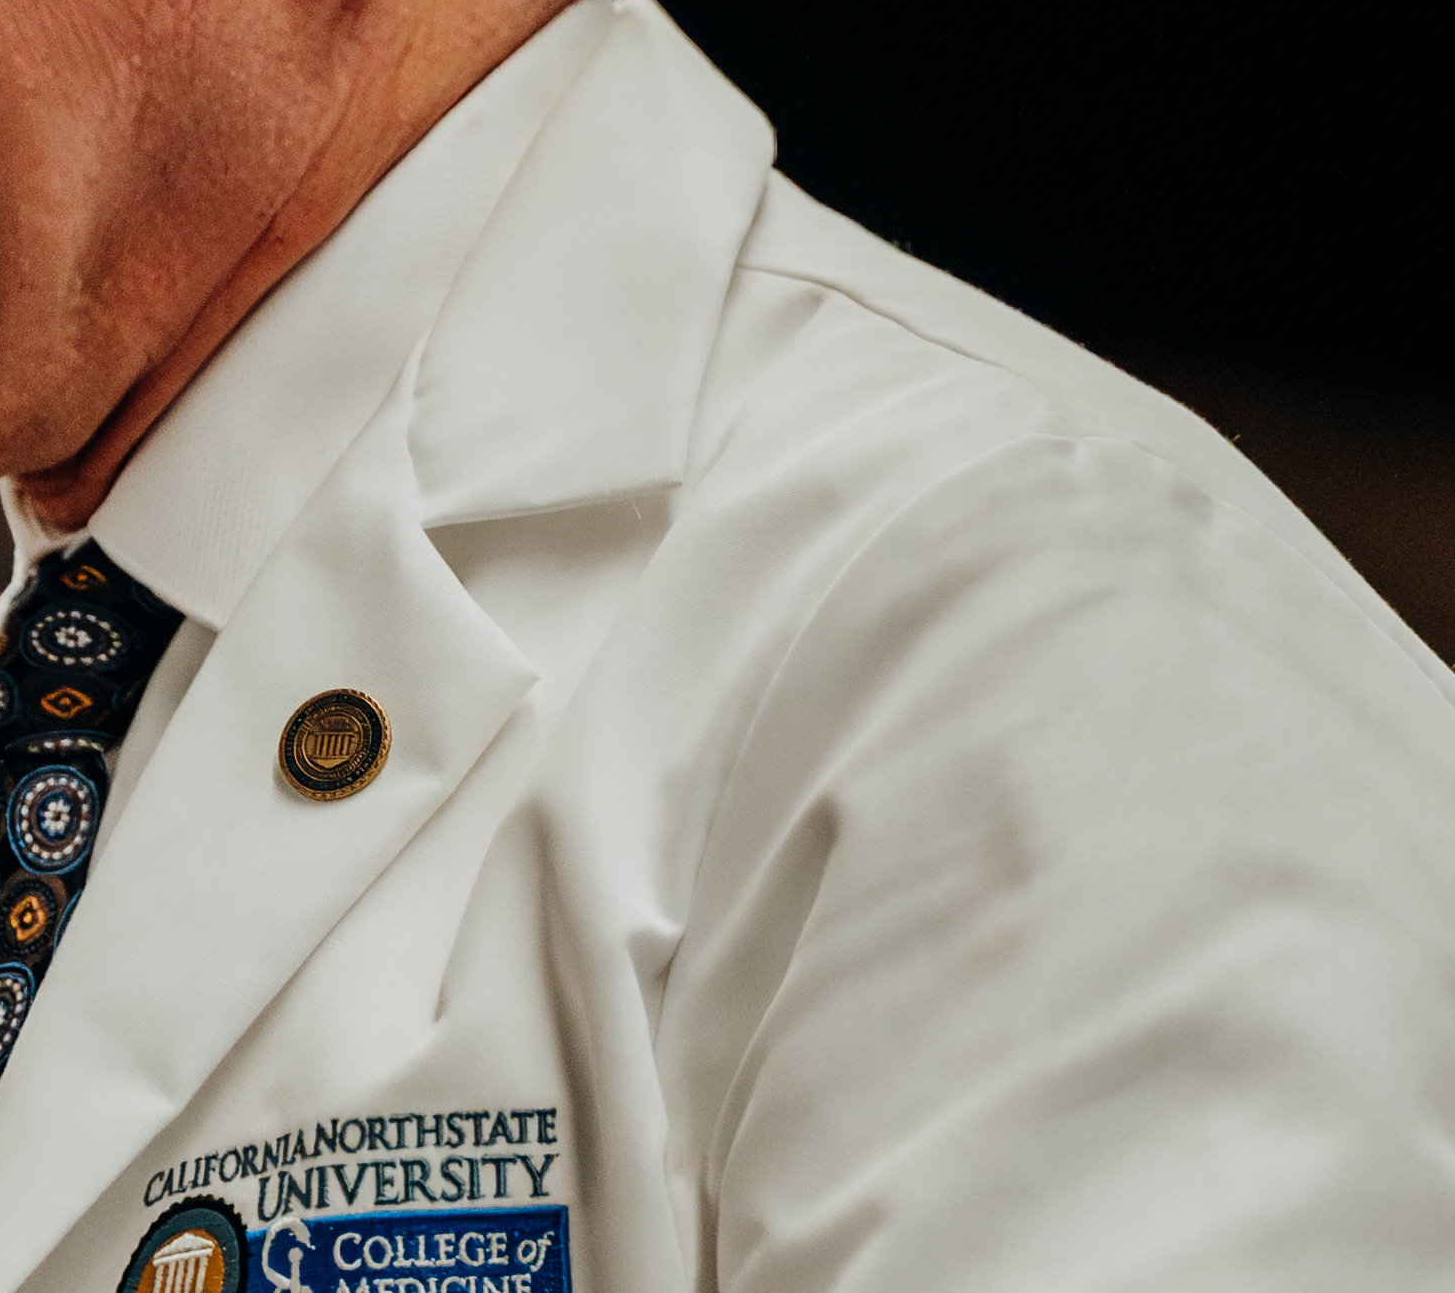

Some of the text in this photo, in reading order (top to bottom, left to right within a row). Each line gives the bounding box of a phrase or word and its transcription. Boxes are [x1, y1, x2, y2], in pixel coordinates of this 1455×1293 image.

[257, 1153, 560, 1222] UNIVERSITY
[333, 1230, 555, 1272] COLLEGE of
